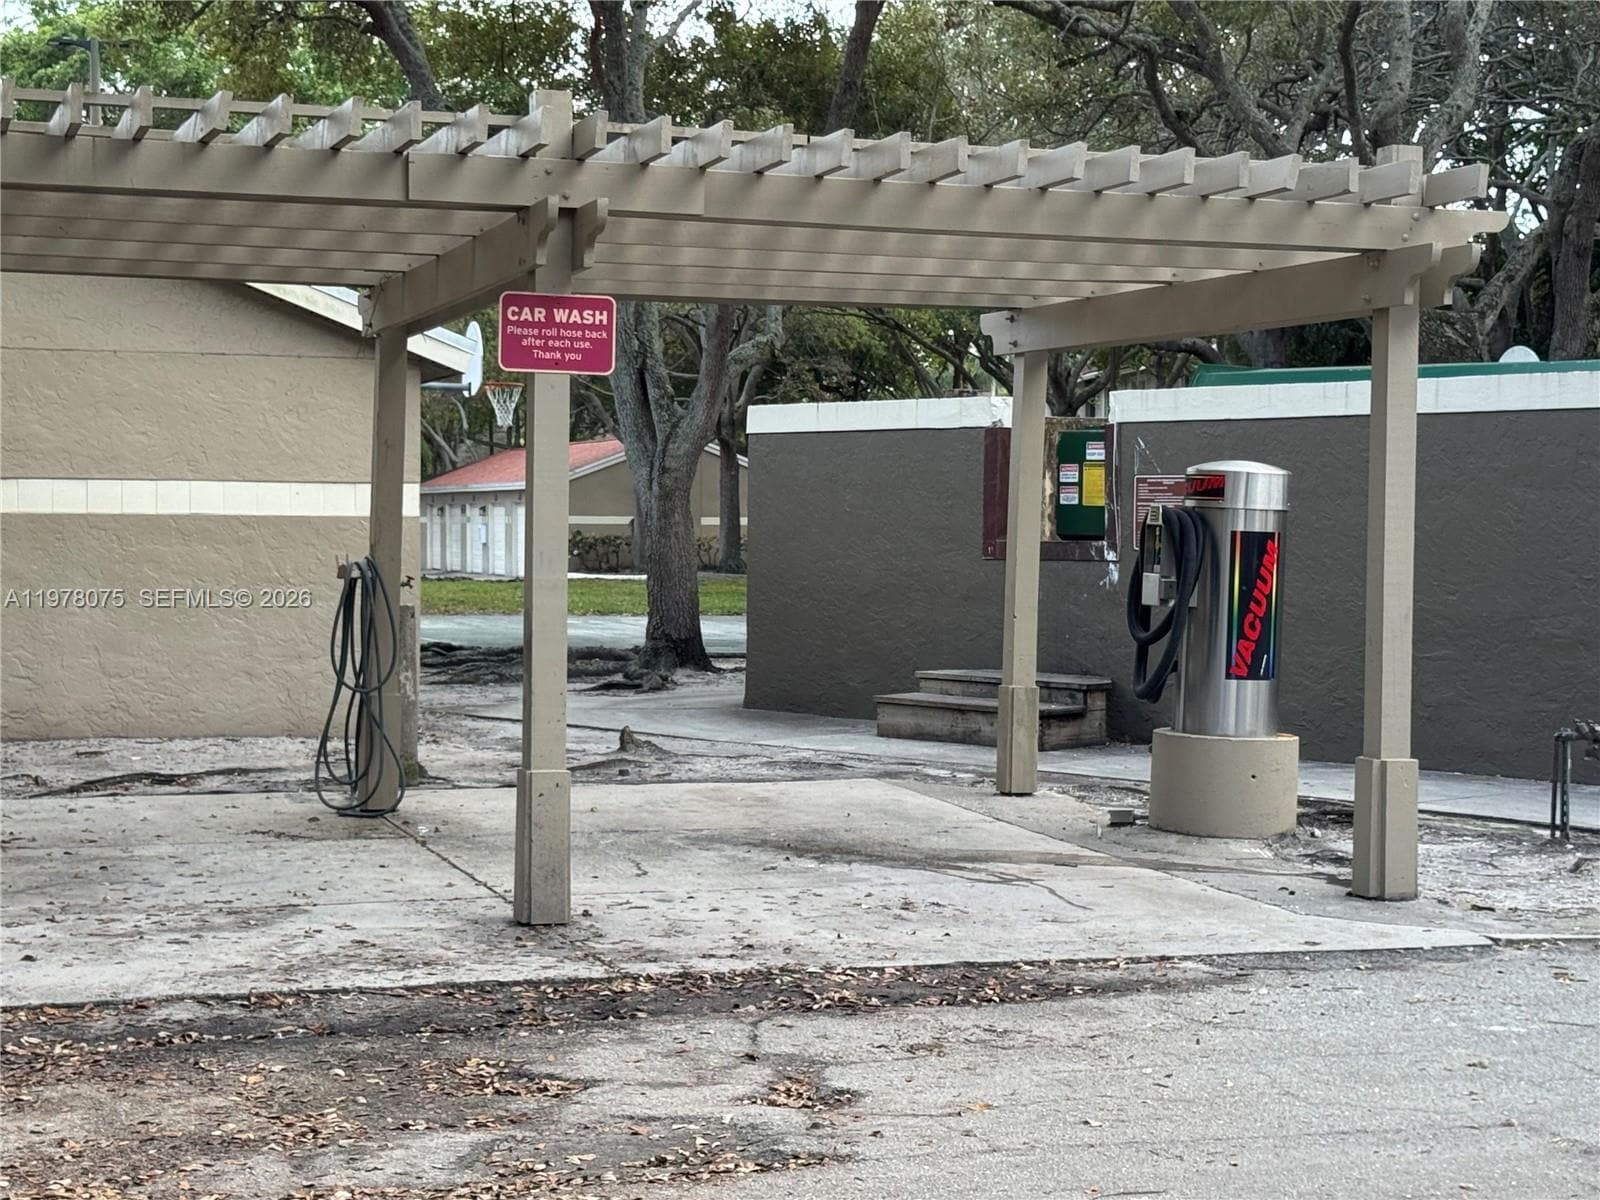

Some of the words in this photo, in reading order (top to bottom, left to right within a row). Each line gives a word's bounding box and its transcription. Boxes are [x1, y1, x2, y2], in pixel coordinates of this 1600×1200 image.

[507, 306, 546, 322] CAR
[553, 308, 608, 325] WASH
[507, 326, 539, 336] Please
[541, 328, 558, 337] roll
[560, 328, 583, 338] hose
[585, 330, 608, 339] back
[521, 338, 546, 347] after
[548, 340, 571, 348] each
[573, 341, 593, 349] use.
[532, 350, 561, 360] Thank
[564, 353, 582, 362] you
[1229, 539, 1279, 677] VACUUM
